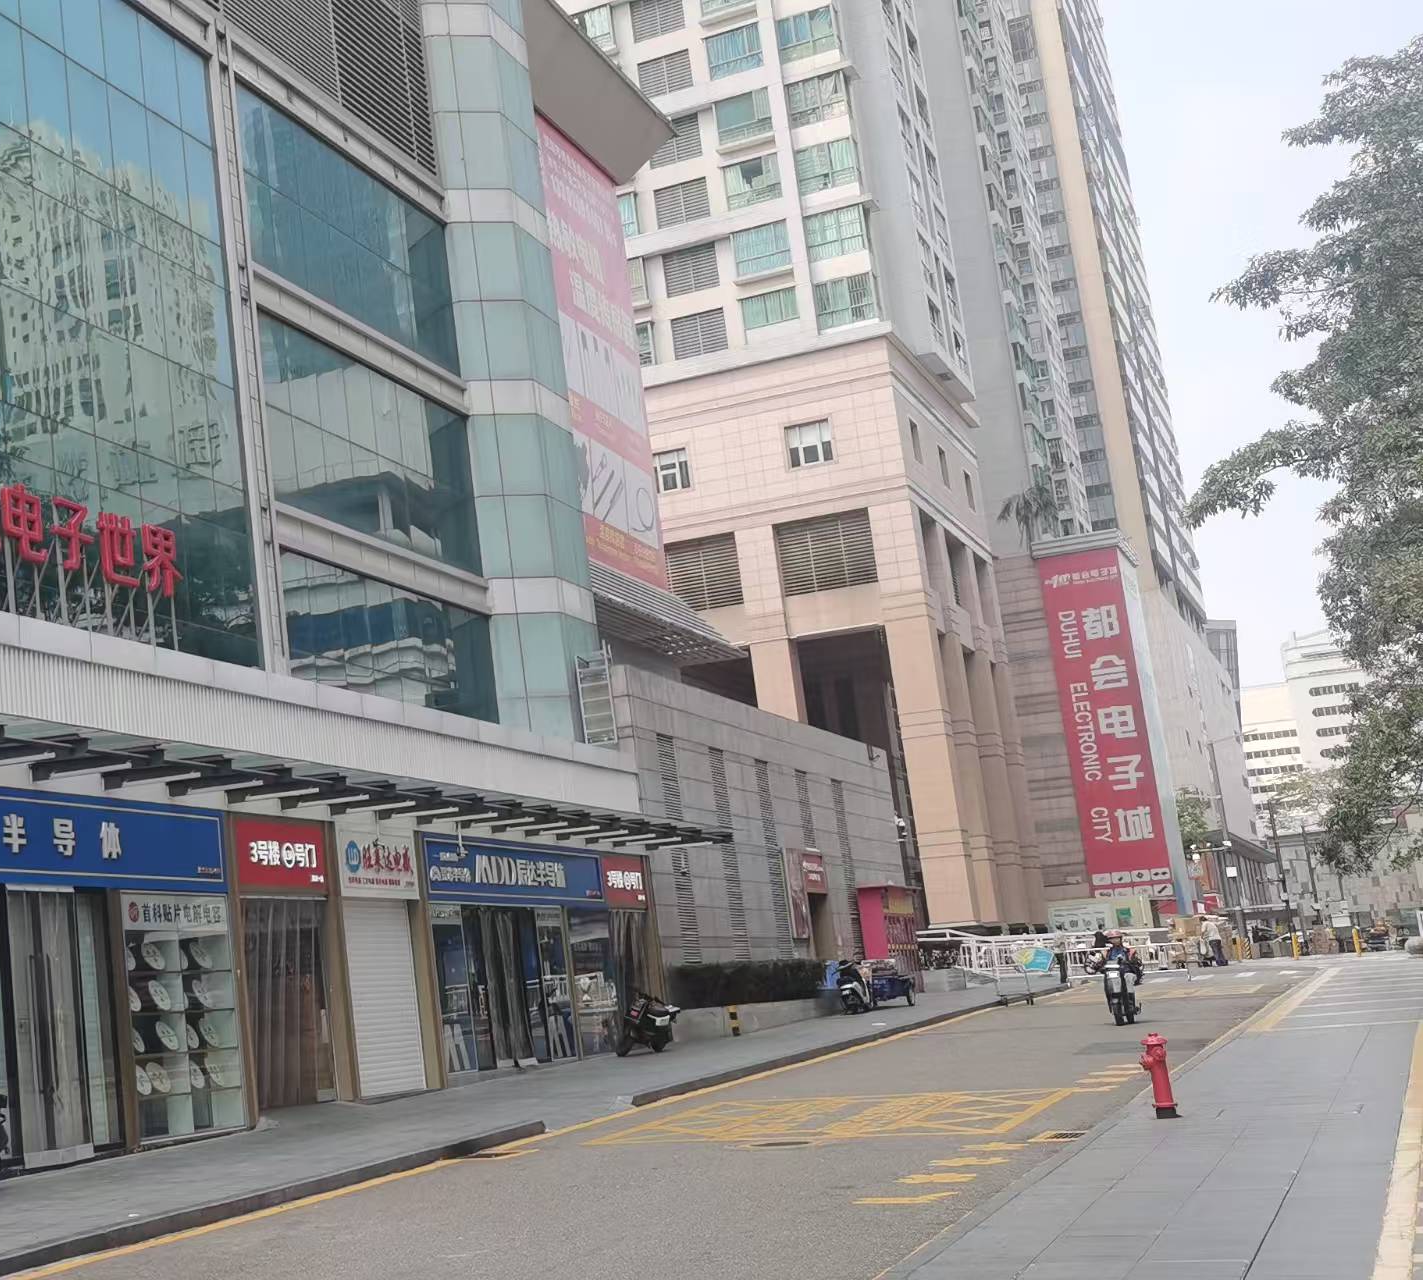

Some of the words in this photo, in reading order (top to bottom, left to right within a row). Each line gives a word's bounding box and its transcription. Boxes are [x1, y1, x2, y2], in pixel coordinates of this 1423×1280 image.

[1057, 610, 1083, 659] DUHUI
[1069, 682, 1103, 782] ELECTRONIC
[1080, 604, 1154, 843] 都会电子城
[1090, 806, 1114, 843] CITY
[249, 840, 281, 866] 3号楼
[475, 854, 517, 886] MDD
[141, 902, 222, 924] 首科贴片电解电容
